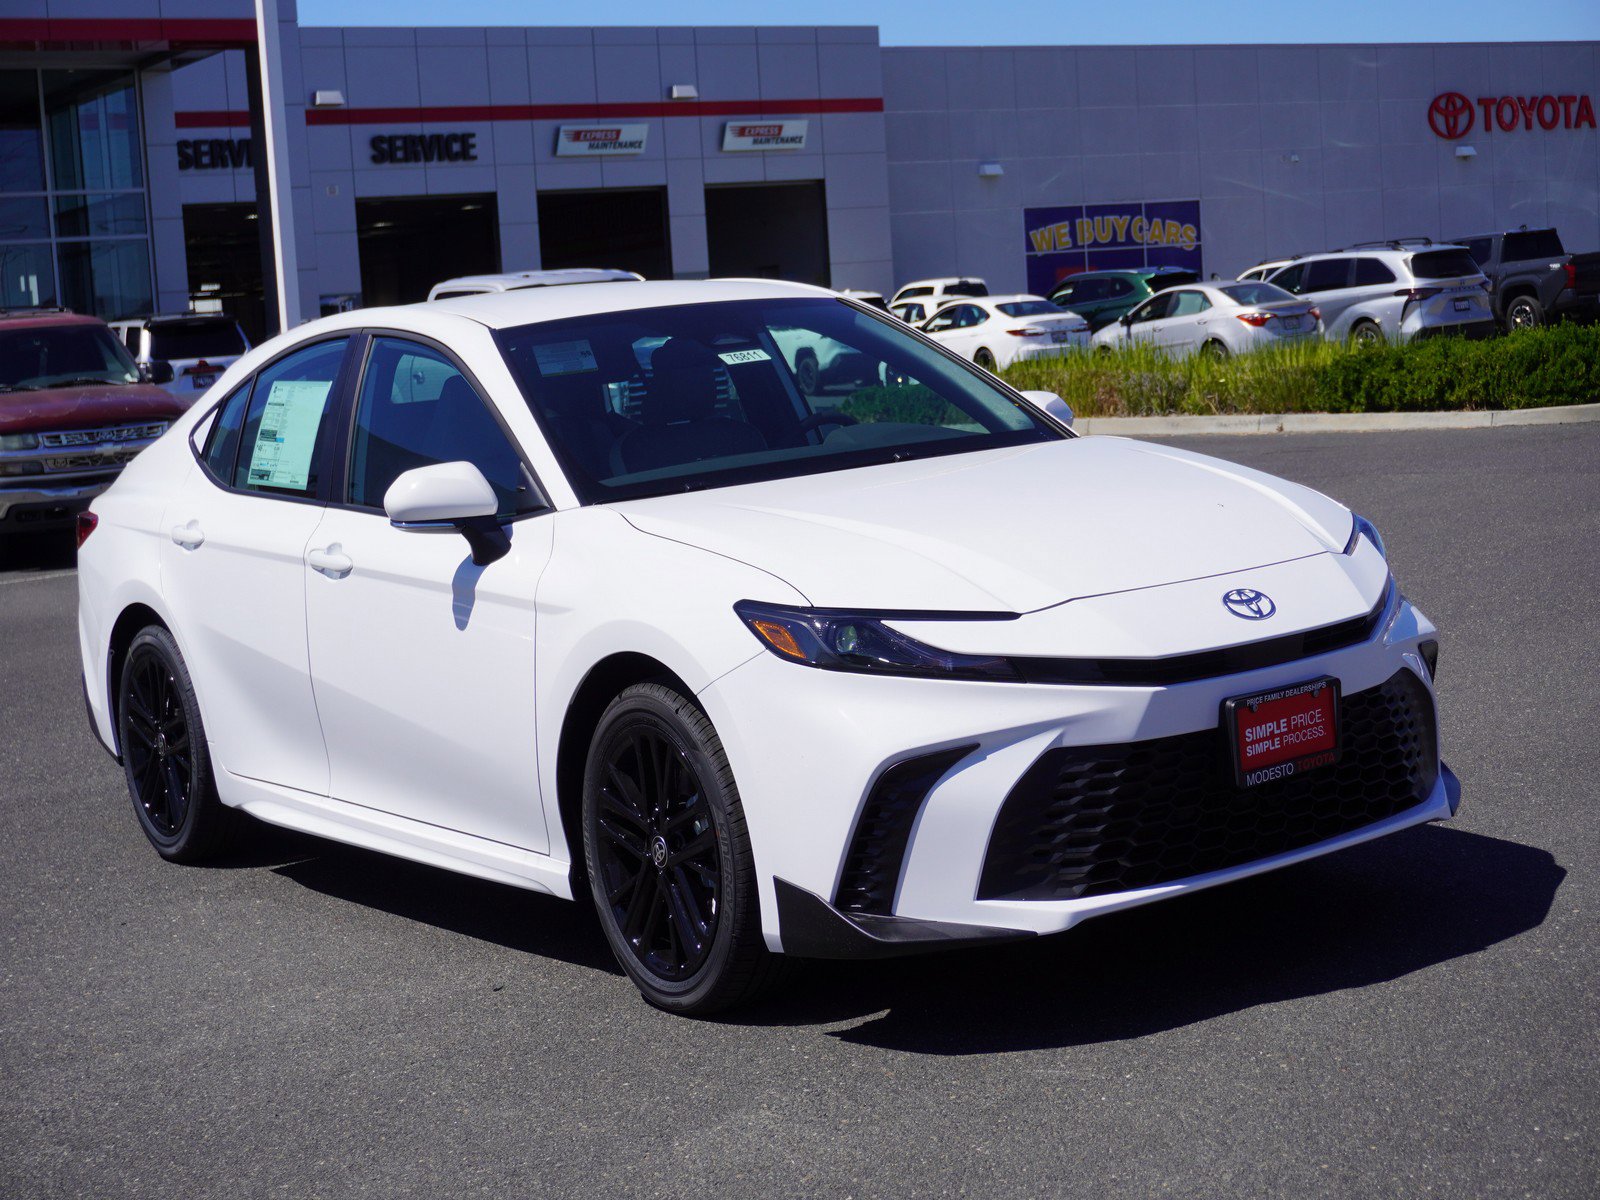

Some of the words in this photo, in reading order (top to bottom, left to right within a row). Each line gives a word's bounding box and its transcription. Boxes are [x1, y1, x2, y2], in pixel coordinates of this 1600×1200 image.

[1477, 95, 1597, 132] TOYOTA
[579, 130, 617, 141] EXPRESS
[588, 140, 644, 151] MAINTENANCE
[744, 126, 779, 136] EXPRESS
[752, 135, 804, 145] MAINTENANCE
[177, 139, 254, 170] SERVI
[370, 132, 478, 165] SERVICE
[1029, 220, 1073, 256] WE
[1075, 214, 1132, 246] BUY
[1130, 215, 1198, 252] CARS
[726, 350, 763, 363] 76811
[1246, 696, 1264, 707] PRICE
[1264, 691, 1285, 702] FAMILY
[1286, 682, 1327, 697] DEALERSHIPS
[1245, 718, 1288, 742] SIMPLE
[1290, 708, 1326, 730] PRICE.
[1246, 737, 1281, 757] SIMPLE
[1282, 725, 1327, 747] PROCESS.
[1246, 763, 1294, 786] MODESTO
[1297, 752, 1335, 770] TOYOTA
